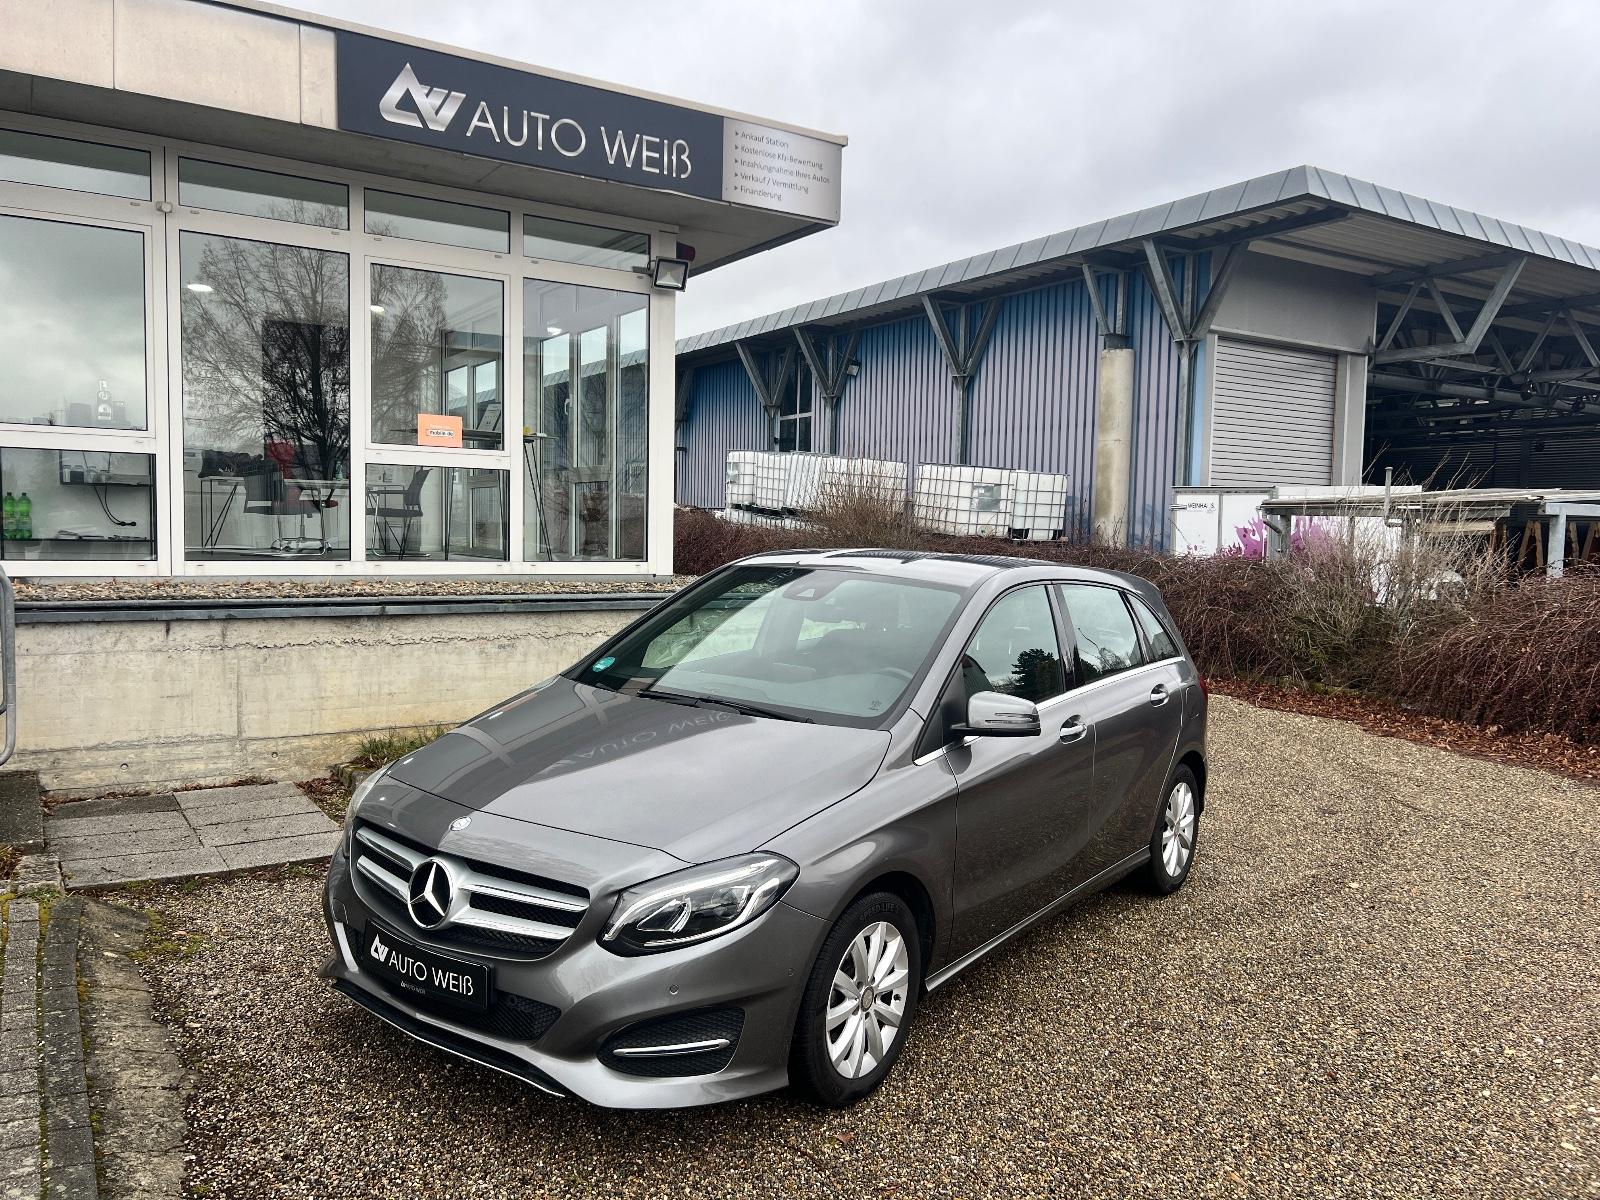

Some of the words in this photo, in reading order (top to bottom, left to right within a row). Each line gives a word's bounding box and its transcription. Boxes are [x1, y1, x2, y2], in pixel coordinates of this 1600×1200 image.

[466, 101, 586, 157] AUTO
[600, 126, 692, 180] WEIß
[740, 131, 764, 143] Ankauf
[765, 137, 789, 148] Station
[740, 145, 776, 159] Kostenlose
[777, 152, 824, 170] Kfz-Bewertung
[740, 159, 794, 177] Inzahlungnahme
[795, 170, 811, 180] Ihres
[812, 174, 830, 184] Autos
[740, 172, 766, 184] Verkauf
[772, 178, 809, 194] Vermittlung
[740, 185, 782, 201] Finanzierung
[389, 950, 428, 981] AUTO
[431, 967, 474, 996] WEIß
